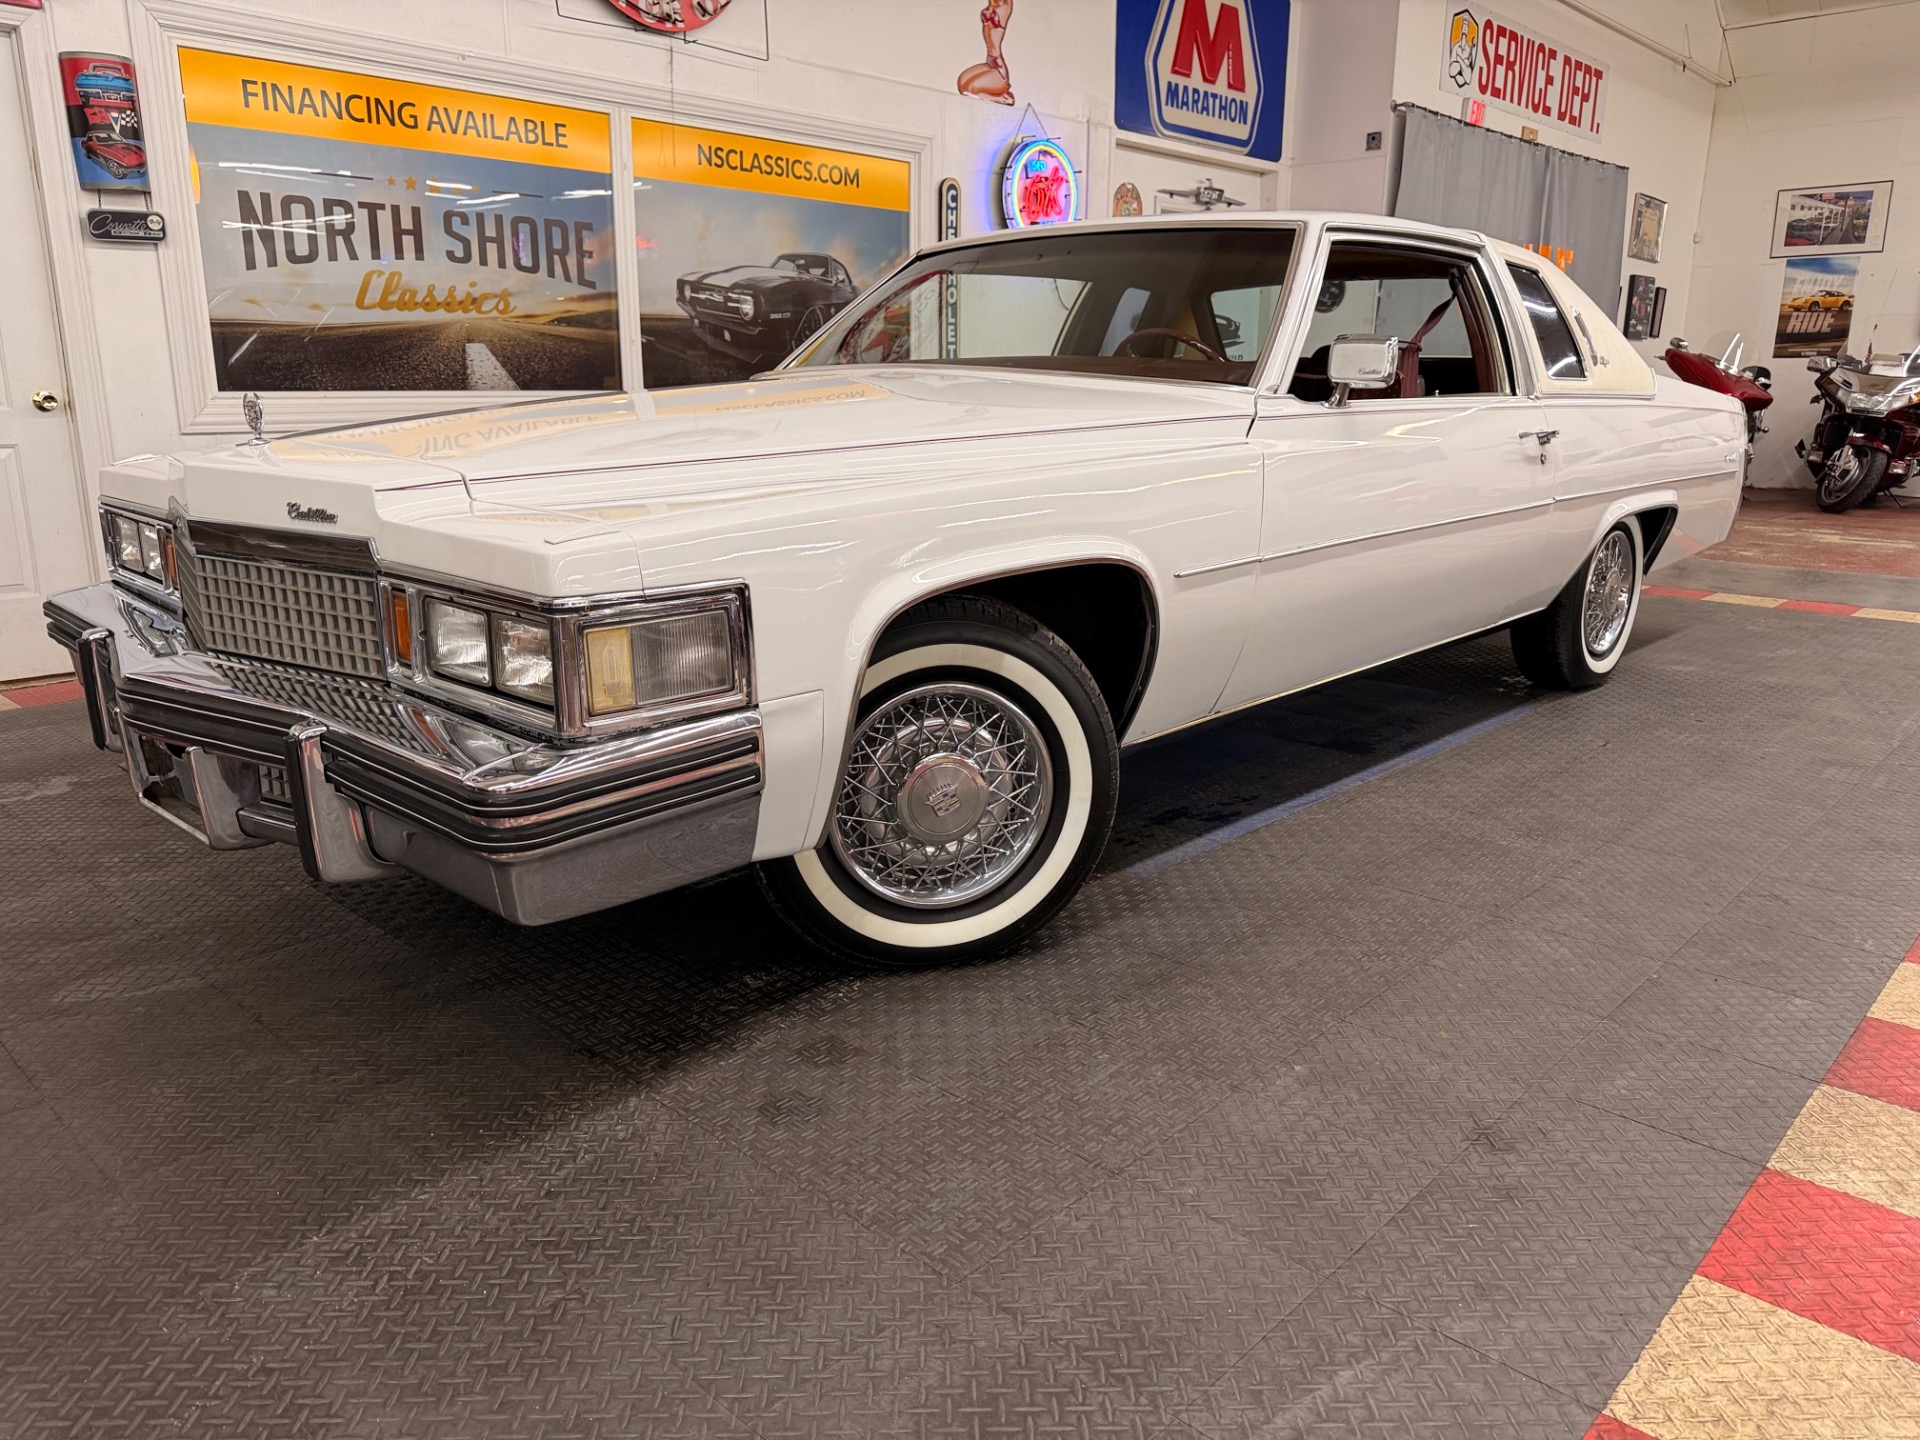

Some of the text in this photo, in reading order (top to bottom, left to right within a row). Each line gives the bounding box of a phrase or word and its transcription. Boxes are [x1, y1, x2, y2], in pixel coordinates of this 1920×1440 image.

[1478, 18, 1603, 134] SERVICE DEPT.
[241, 78, 568, 149] FINANCING AVAILABLE
[1165, 81, 1249, 126] MARATHON
[697, 144, 860, 189] NSCLASSICS.COM
[90, 213, 147, 234] Corvette
[237, 189, 597, 290] NORTH SHORE
[355, 269, 517, 316] Classics
[946, 189, 957, 359] CHEROLET
[1786, 311, 1835, 333] RIDE
[286, 502, 338, 524] Cadillac
